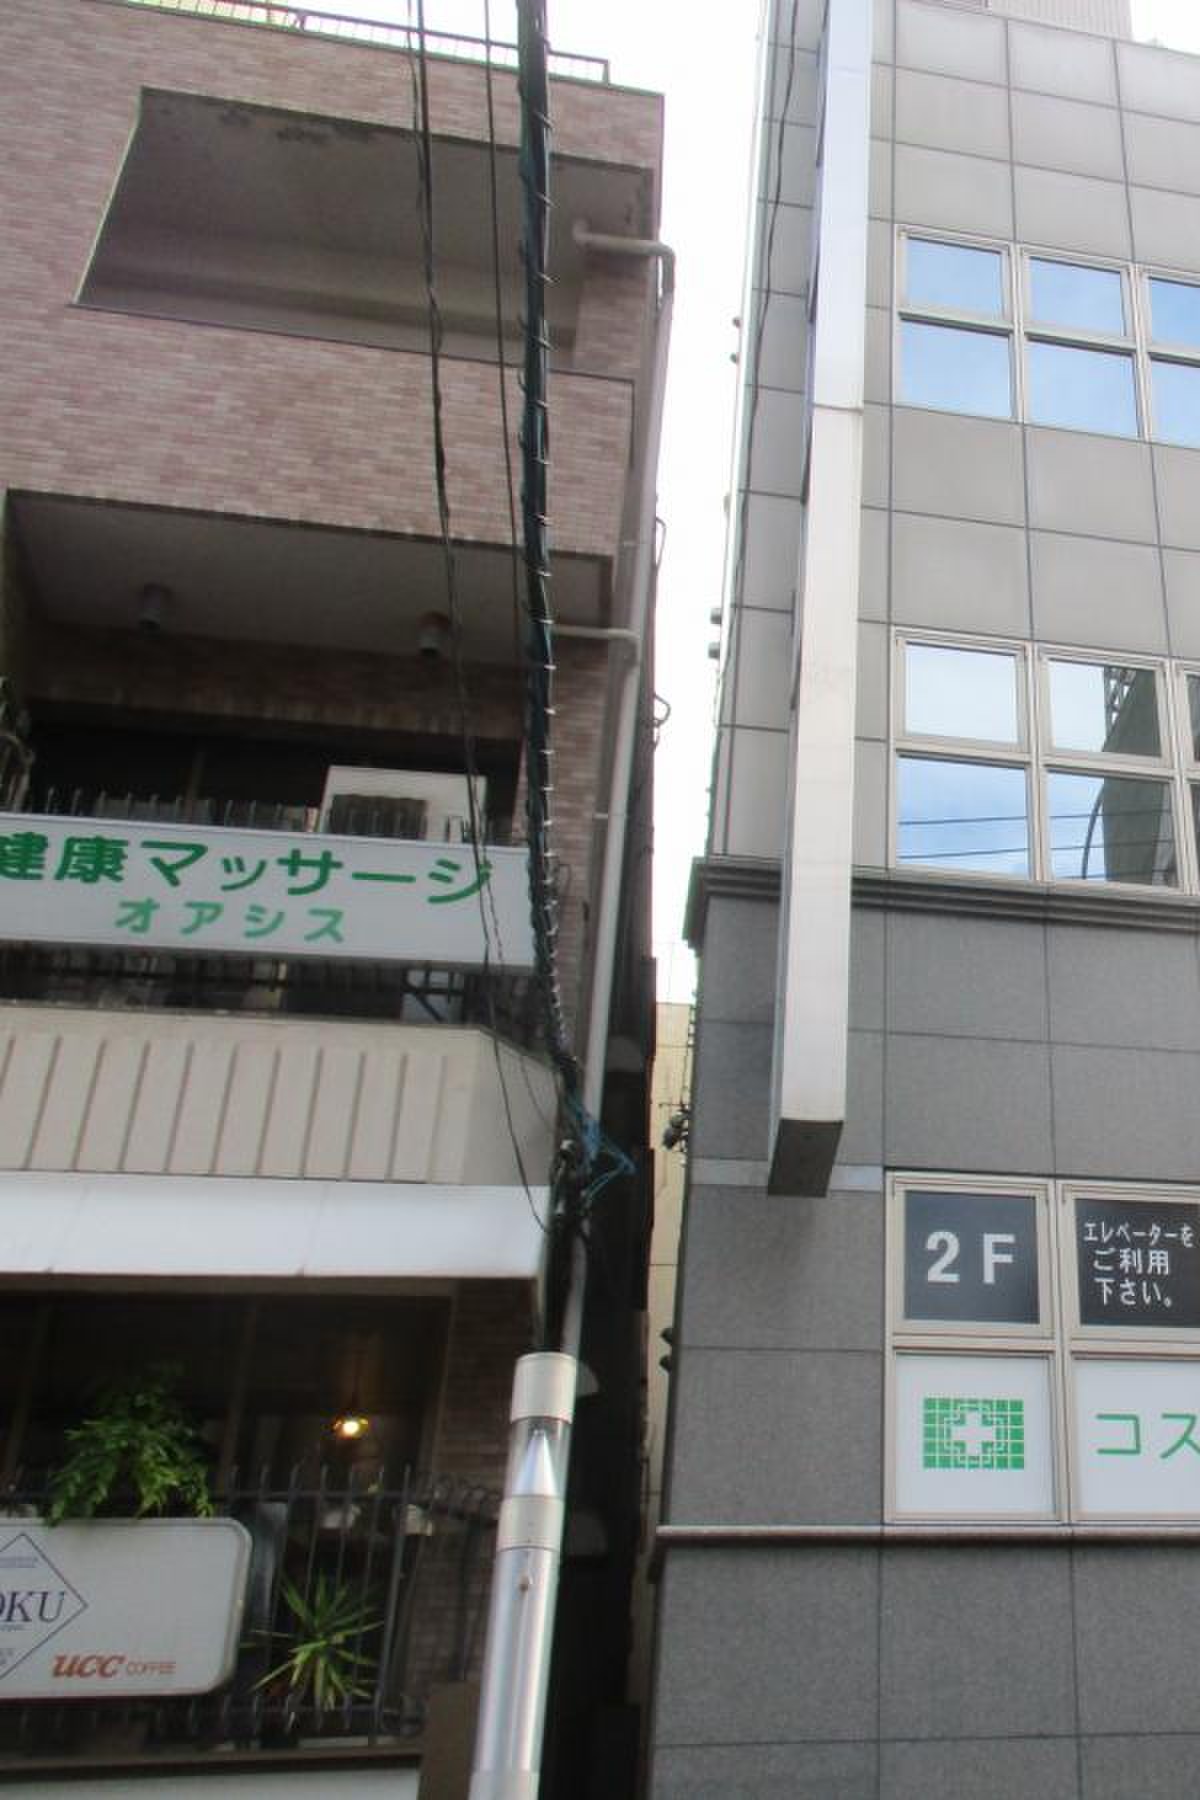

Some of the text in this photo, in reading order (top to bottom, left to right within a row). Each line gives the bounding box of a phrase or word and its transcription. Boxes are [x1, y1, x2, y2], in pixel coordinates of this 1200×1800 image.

[0, 831, 492, 904] 健康マッサージ
[115, 899, 345, 943] オアシス
[1083, 1220, 1195, 1249] エレベーターを
[1093, 1247, 1170, 1276] ご利用
[1094, 1277, 1173, 1308] 下さい。
